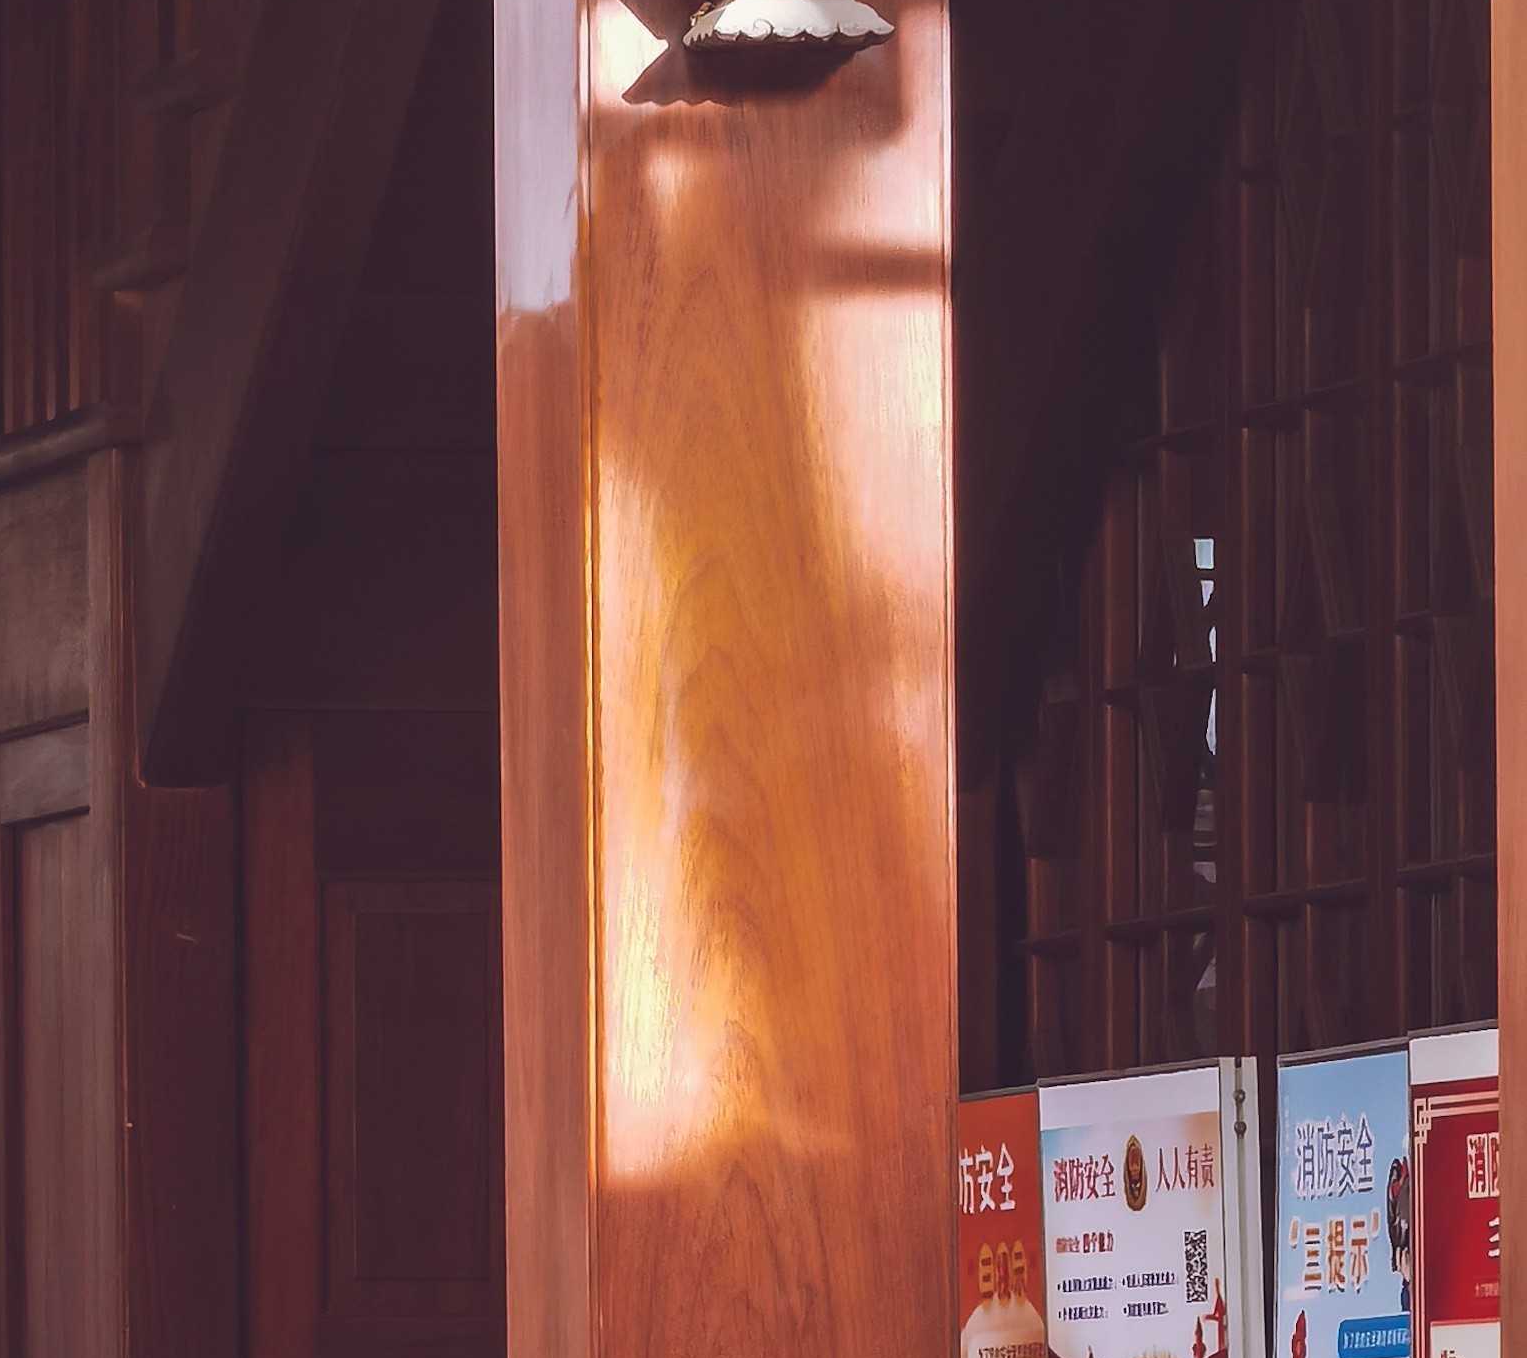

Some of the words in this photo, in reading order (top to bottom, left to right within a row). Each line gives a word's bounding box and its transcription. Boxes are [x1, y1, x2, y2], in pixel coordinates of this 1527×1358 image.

[1053, 1154, 1116, 1202] 消防安全
[1155, 1144, 1215, 1192] 人人有责
[1296, 1117, 1375, 1199] 消防安全
